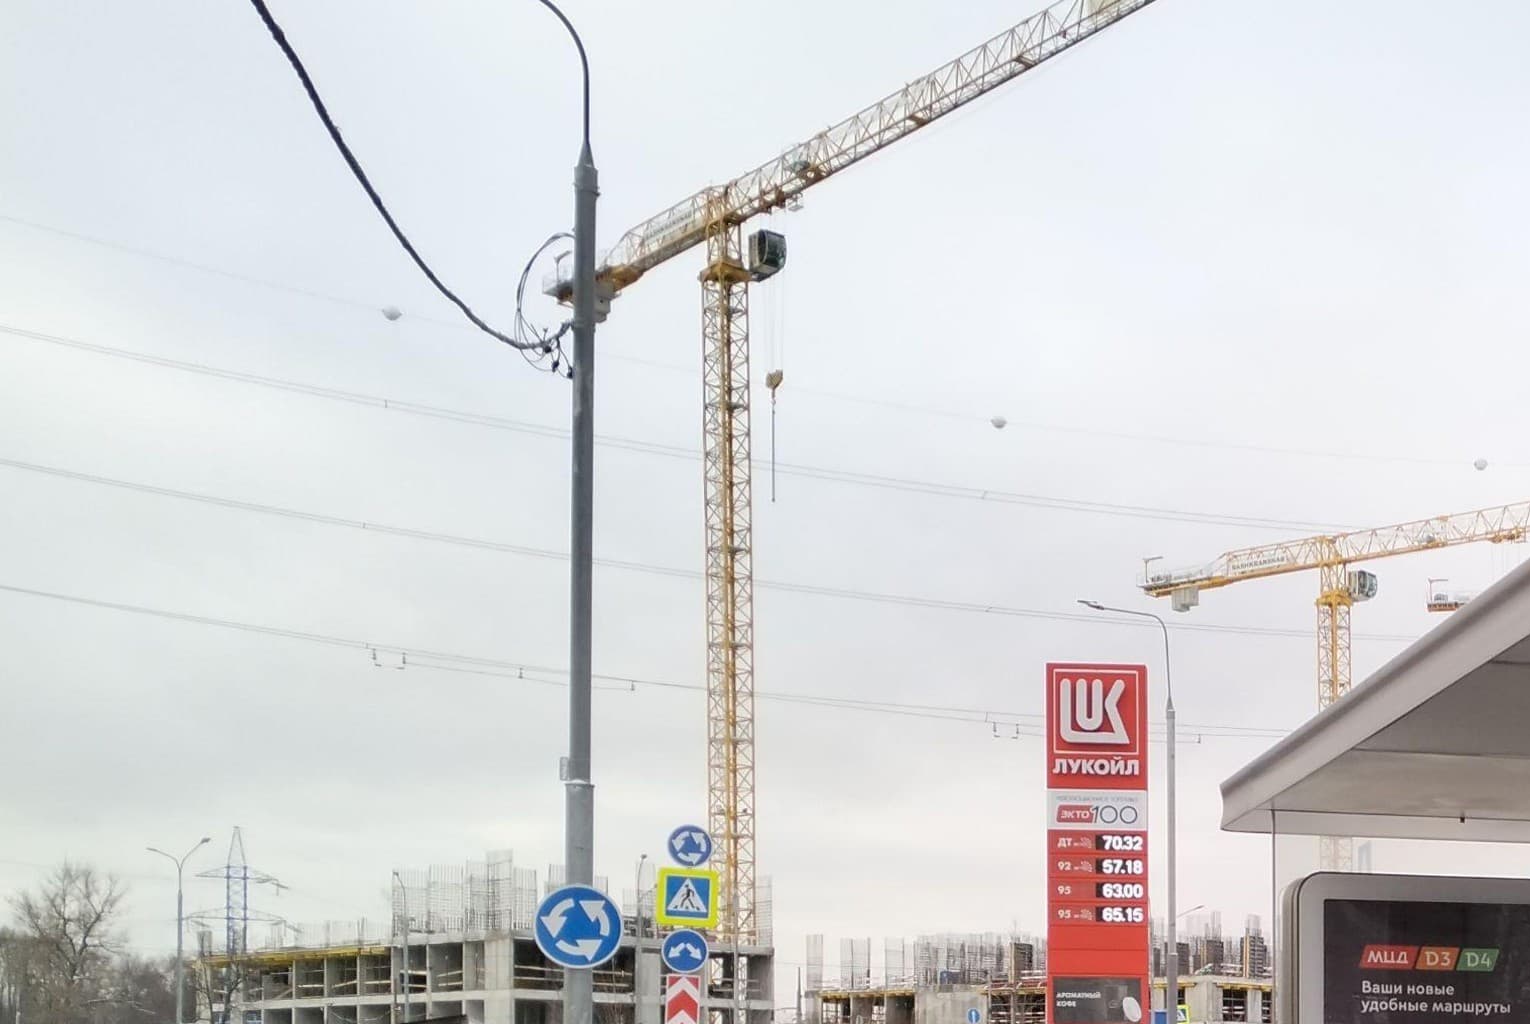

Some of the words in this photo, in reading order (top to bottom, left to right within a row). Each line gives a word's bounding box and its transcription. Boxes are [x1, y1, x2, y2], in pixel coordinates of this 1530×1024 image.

[1053, 756, 1140, 776] ЛУКОЙЛ
[1057, 838, 1073, 848] ДТ
[1057, 861, 1071, 871] 92
[1102, 859, 1143, 874] 57.18
[1057, 886, 1071, 895] 95
[1102, 883, 1144, 898] 63.00
[1057, 910, 1071, 919] 95
[1102, 907, 1144, 922] 65.15
[1367, 951, 1409, 965] МЦД
[1425, 951, 1451, 967] D3
[1464, 951, 1491, 968] D4
[1361, 980, 1403, 995] Ваши
[1407, 984, 1455, 996] новые
[1360, 998, 1428, 1013] удобные
[1432, 1002, 1511, 1016] маршруты
